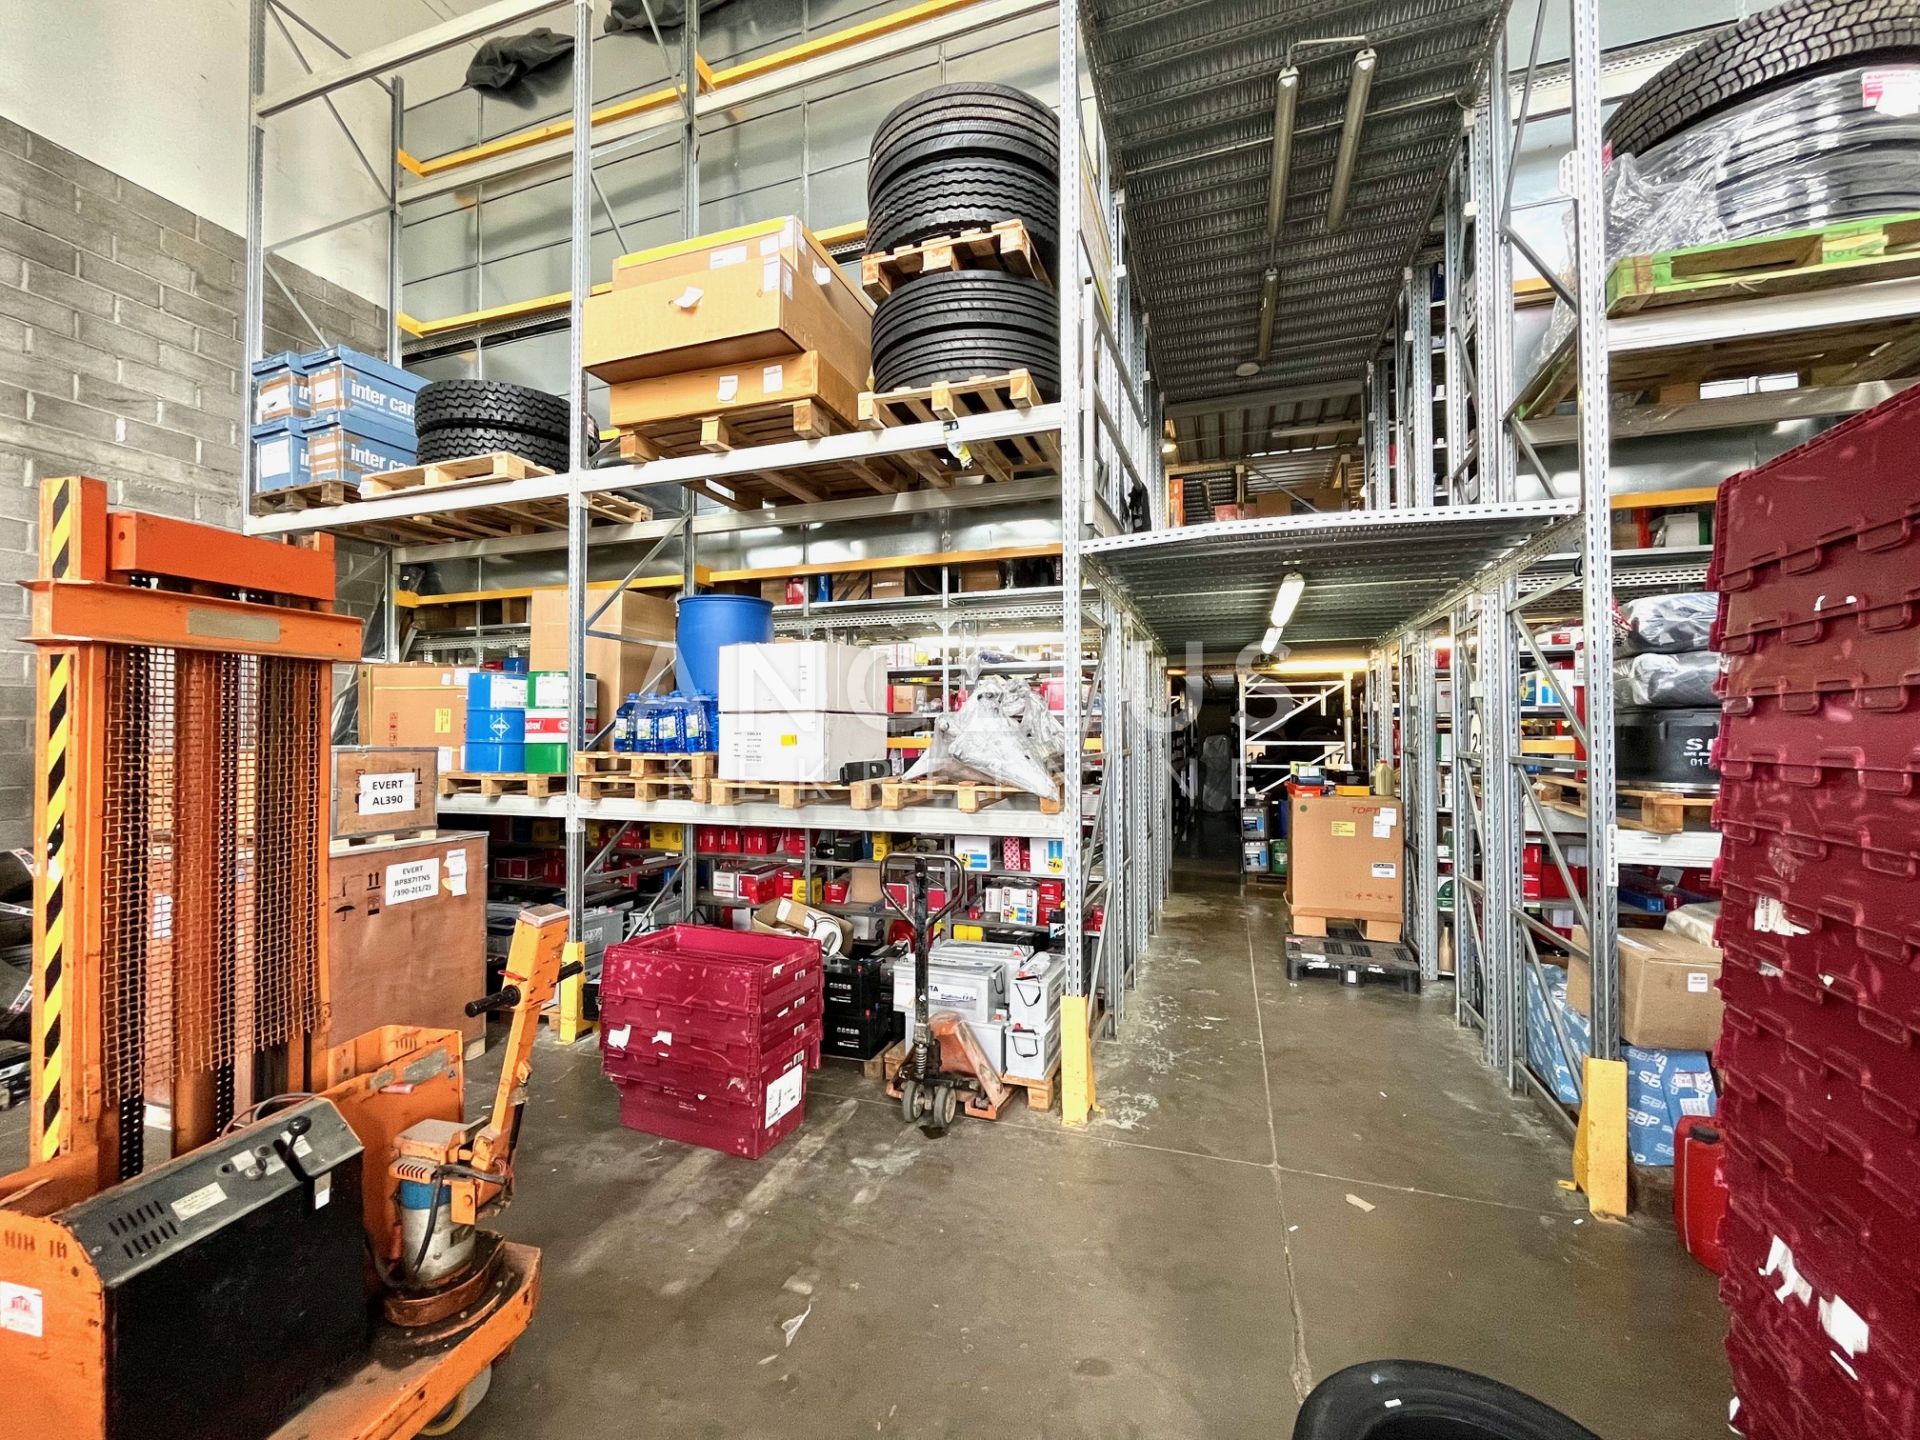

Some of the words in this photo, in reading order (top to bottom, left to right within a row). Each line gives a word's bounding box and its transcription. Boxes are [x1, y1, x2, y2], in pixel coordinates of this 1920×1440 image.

[351, 380, 387, 406] inter
[389, 397, 415, 415] car
[351, 444, 387, 469] inter
[1327, 752, 1345, 765] 17
[372, 780, 404, 791] EVERT
[372, 795, 404, 806] AL390
[402, 865, 424, 875] EVERT
[1627, 1107, 1660, 1127] SBP
